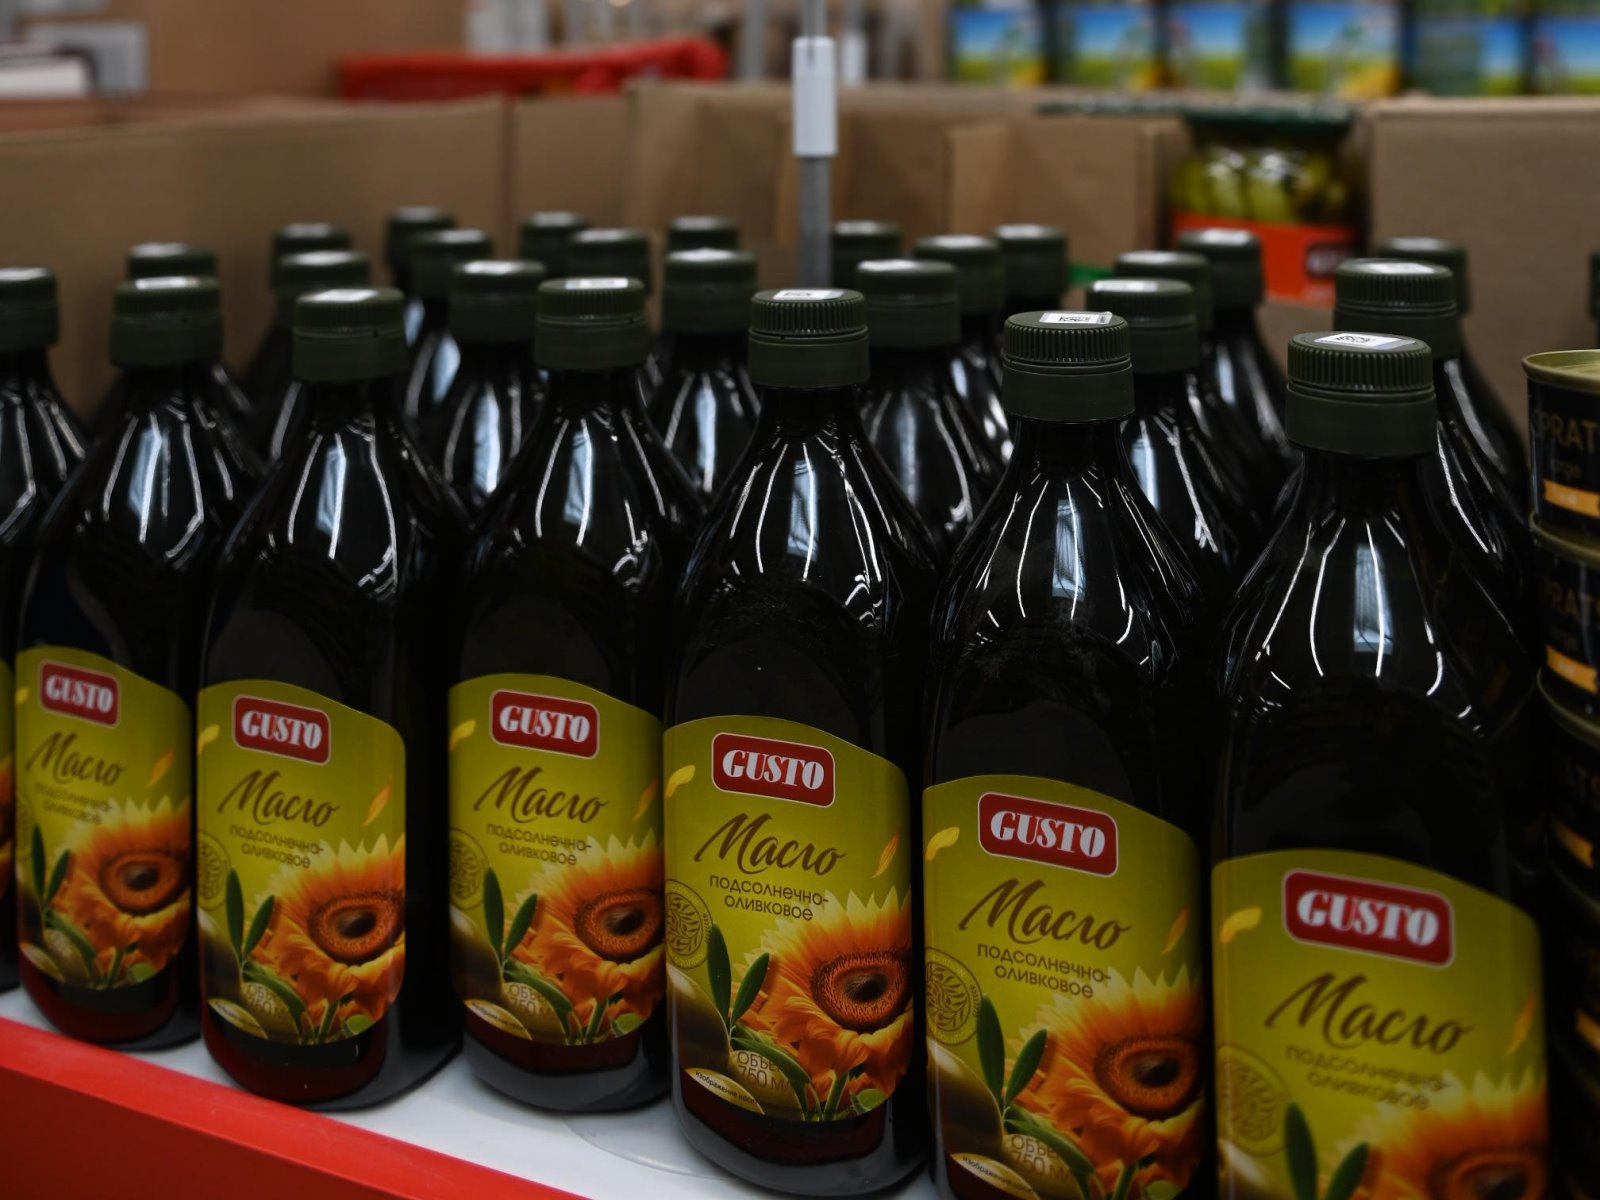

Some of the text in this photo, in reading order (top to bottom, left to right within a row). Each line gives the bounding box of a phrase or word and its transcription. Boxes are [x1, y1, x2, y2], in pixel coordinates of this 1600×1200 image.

[45, 673, 115, 714] GUSTO
[241, 710, 323, 750] GUSTO
[499, 704, 591, 743] GUSTO
[24, 731, 127, 786] Масло
[722, 748, 825, 790] GUSTO
[217, 769, 340, 827] Масло
[473, 766, 607, 824] Масло
[486, 823, 592, 852] подсолнечно-
[499, 842, 577, 866] оливковое
[694, 813, 847, 876] Масло
[990, 809, 1106, 859] GUSTO
[709, 873, 829, 906] подсолнечно-
[724, 892, 814, 921] оливковое
[958, 878, 1132, 950] Масло
[1295, 888, 1439, 947] GUSTO
[977, 943, 1112, 983] подсолнечно-
[994, 964, 1095, 999] оливковое
[1263, 971, 1475, 1055] Масло
[737, 1064, 768, 1089] 750
